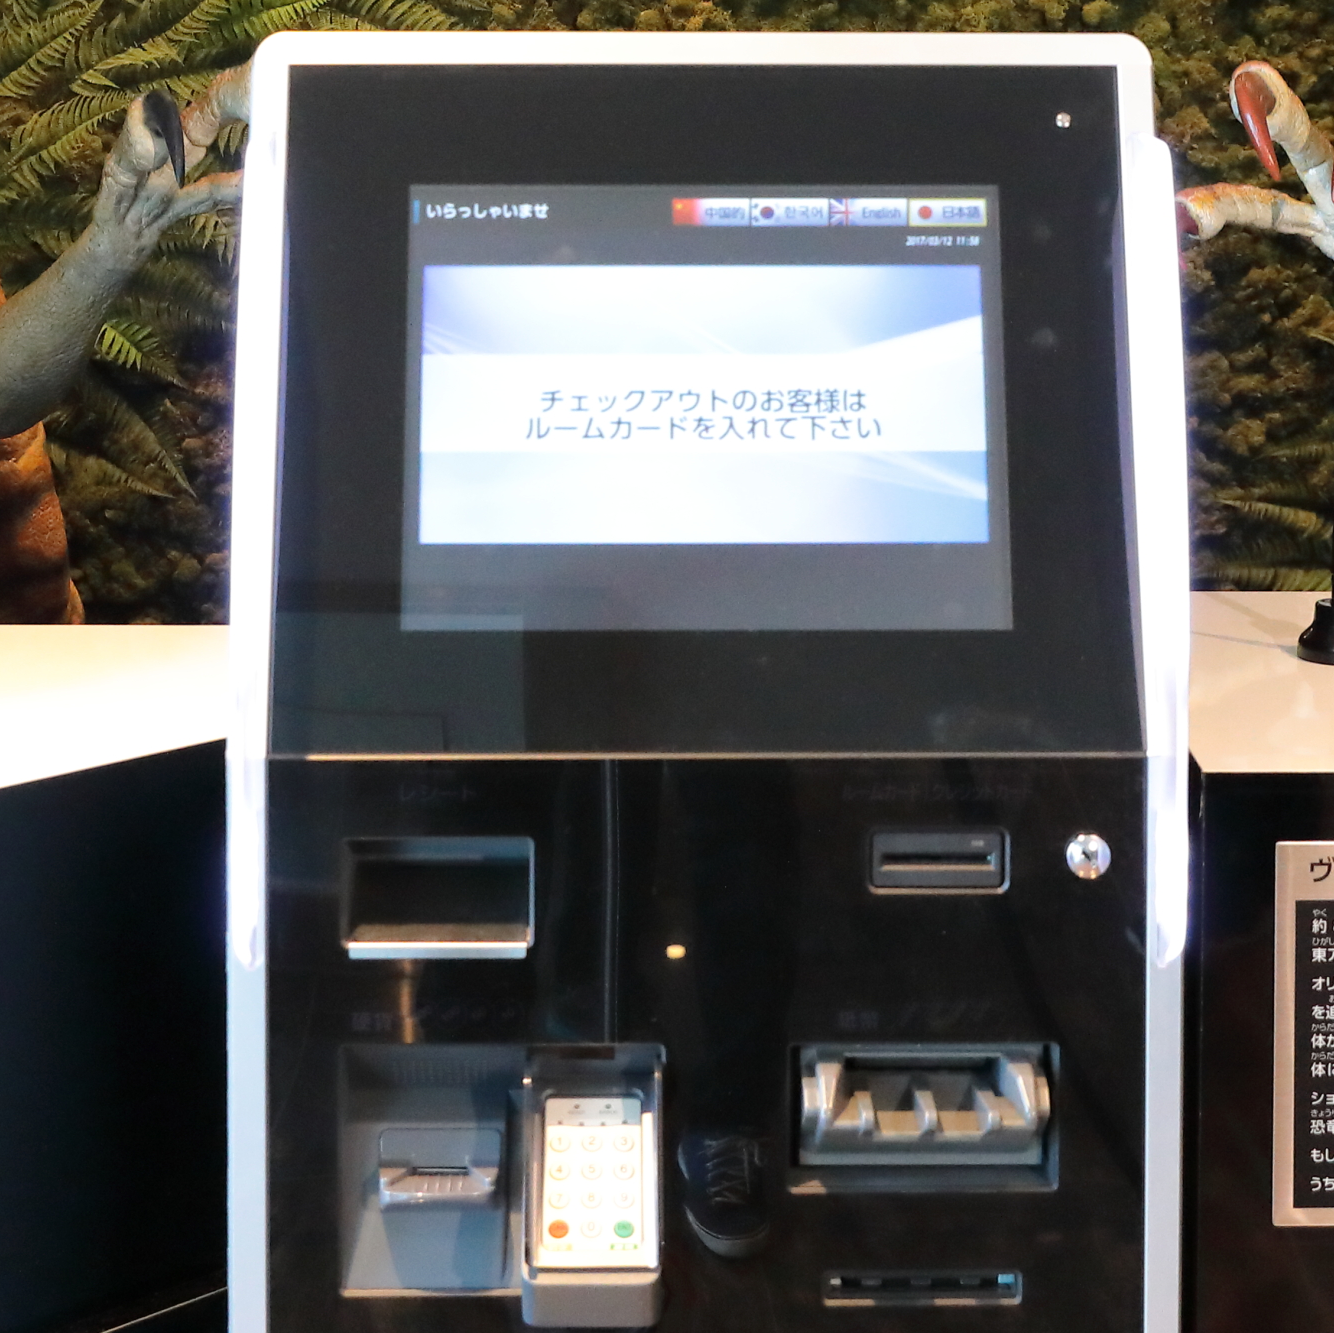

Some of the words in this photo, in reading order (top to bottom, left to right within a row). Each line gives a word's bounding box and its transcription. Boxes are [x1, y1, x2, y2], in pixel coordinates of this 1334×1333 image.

[426, 202, 549, 220] いらっしゃいませ
[861, 207, 901, 221] English
[942, 205, 981, 220] 日本語
[540, 388, 867, 414] チェックアウトのお客様は
[525, 414, 883, 441] ルームカードを入れて下さい
[1312, 918, 1327, 934] 約
